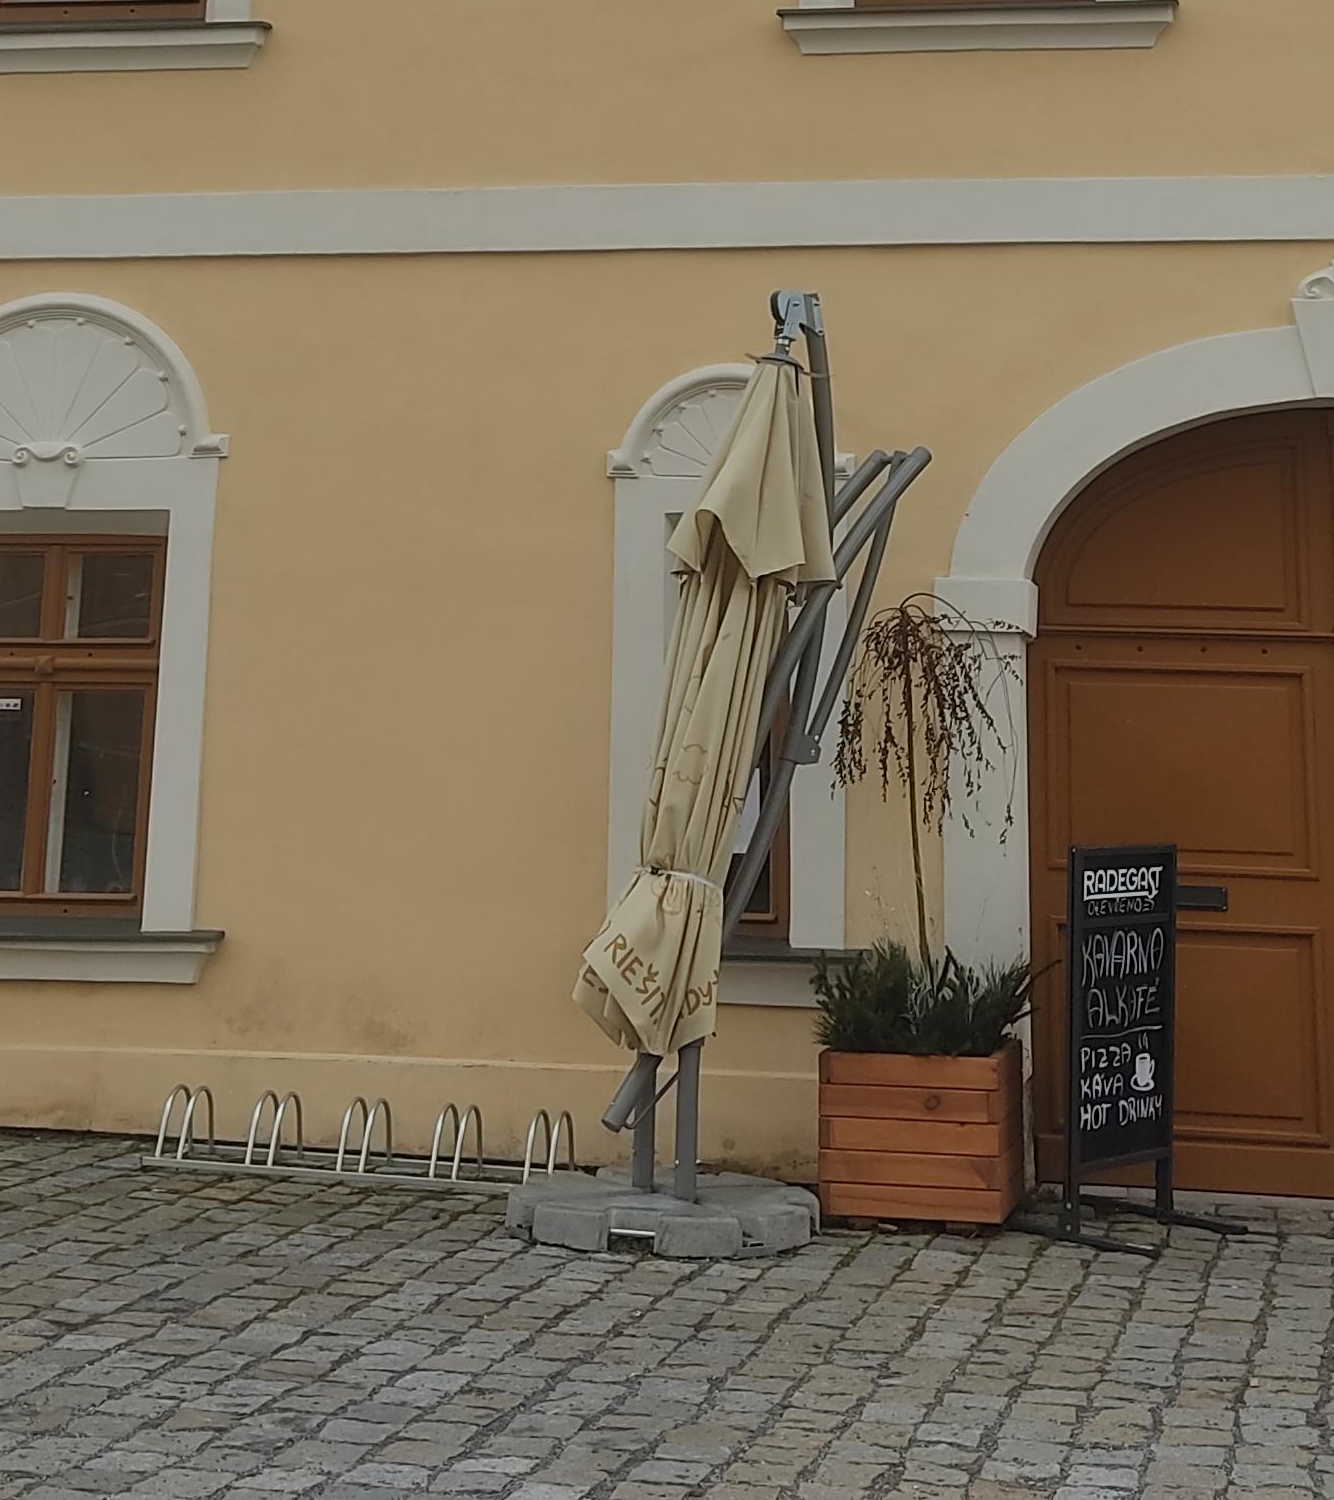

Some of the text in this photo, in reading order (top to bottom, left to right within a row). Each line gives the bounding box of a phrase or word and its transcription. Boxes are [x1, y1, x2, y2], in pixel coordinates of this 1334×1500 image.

[1083, 866, 1163, 900] RADEGAST
[1080, 1042, 1132, 1074] PIZZA
[1080, 1072, 1124, 1100] KÁVA
[1079, 1093, 1164, 1131] HOT DRINKY
